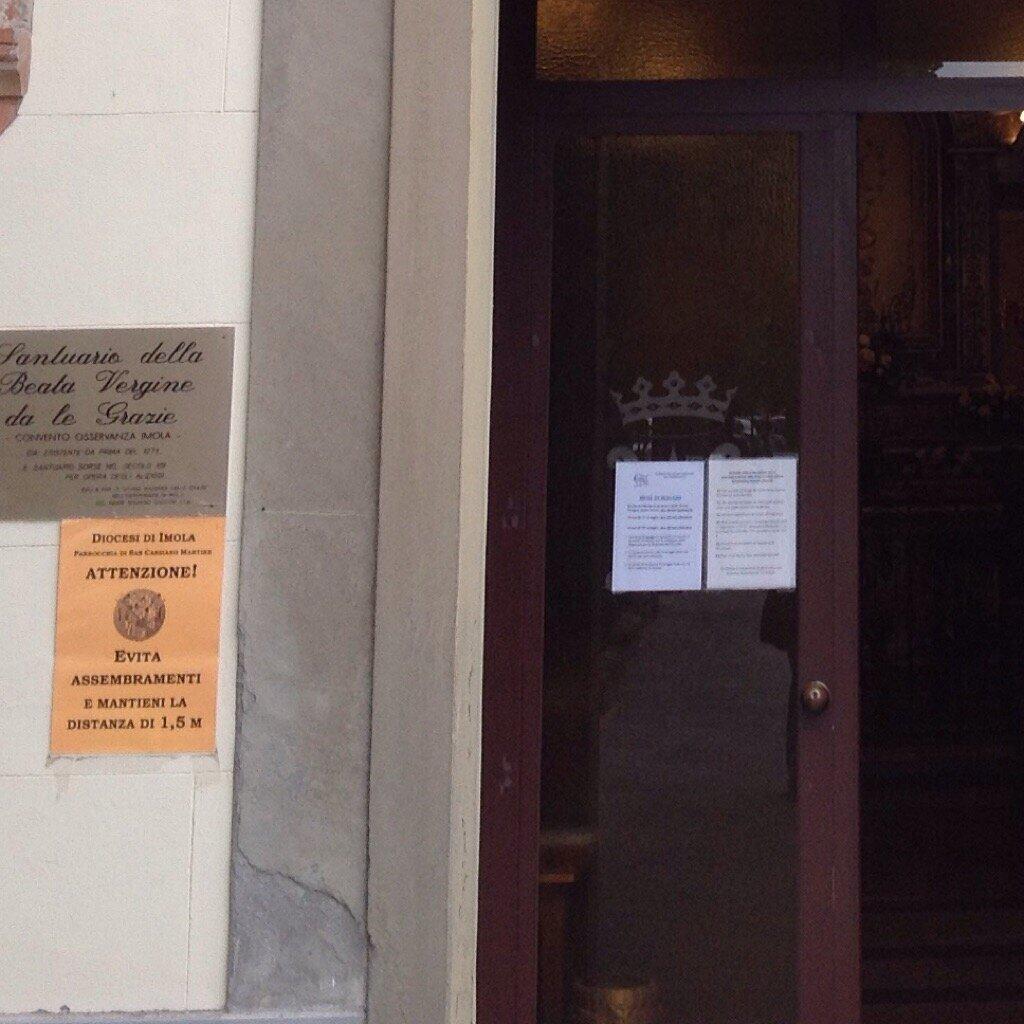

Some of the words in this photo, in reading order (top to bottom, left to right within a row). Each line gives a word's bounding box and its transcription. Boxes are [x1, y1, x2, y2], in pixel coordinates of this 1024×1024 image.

[0, 342, 122, 366] Santuario
[140, 341, 204, 364] della
[0, 371, 75, 395] Beata
[95, 370, 195, 400] Vergine
[5, 404, 34, 426] da
[52, 403, 76, 426] le
[96, 401, 178, 425] Grazie
[15, 433, 70, 442] CONVENTO
[75, 432, 135, 441] OSSERVANZA
[141, 432, 171, 440] IMOLA
[92, 533, 140, 544] DIOCESI
[144, 534, 155, 543] DI
[159, 532, 196, 543] IMOLA
[85, 564, 198, 580] ATTENZIONE!
[114, 650, 162, 663] EVITA
[71, 673, 201, 686] ASSEMBRAMENTI
[84, 699, 93, 709] E
[97, 698, 165, 709] MANTIENI
[170, 698, 187, 708] LA
[67, 719, 134, 730] DISTANZA
[140, 718, 154, 729] DI
[160, 716, 186, 731] 1,5
[190, 718, 202, 728] M
